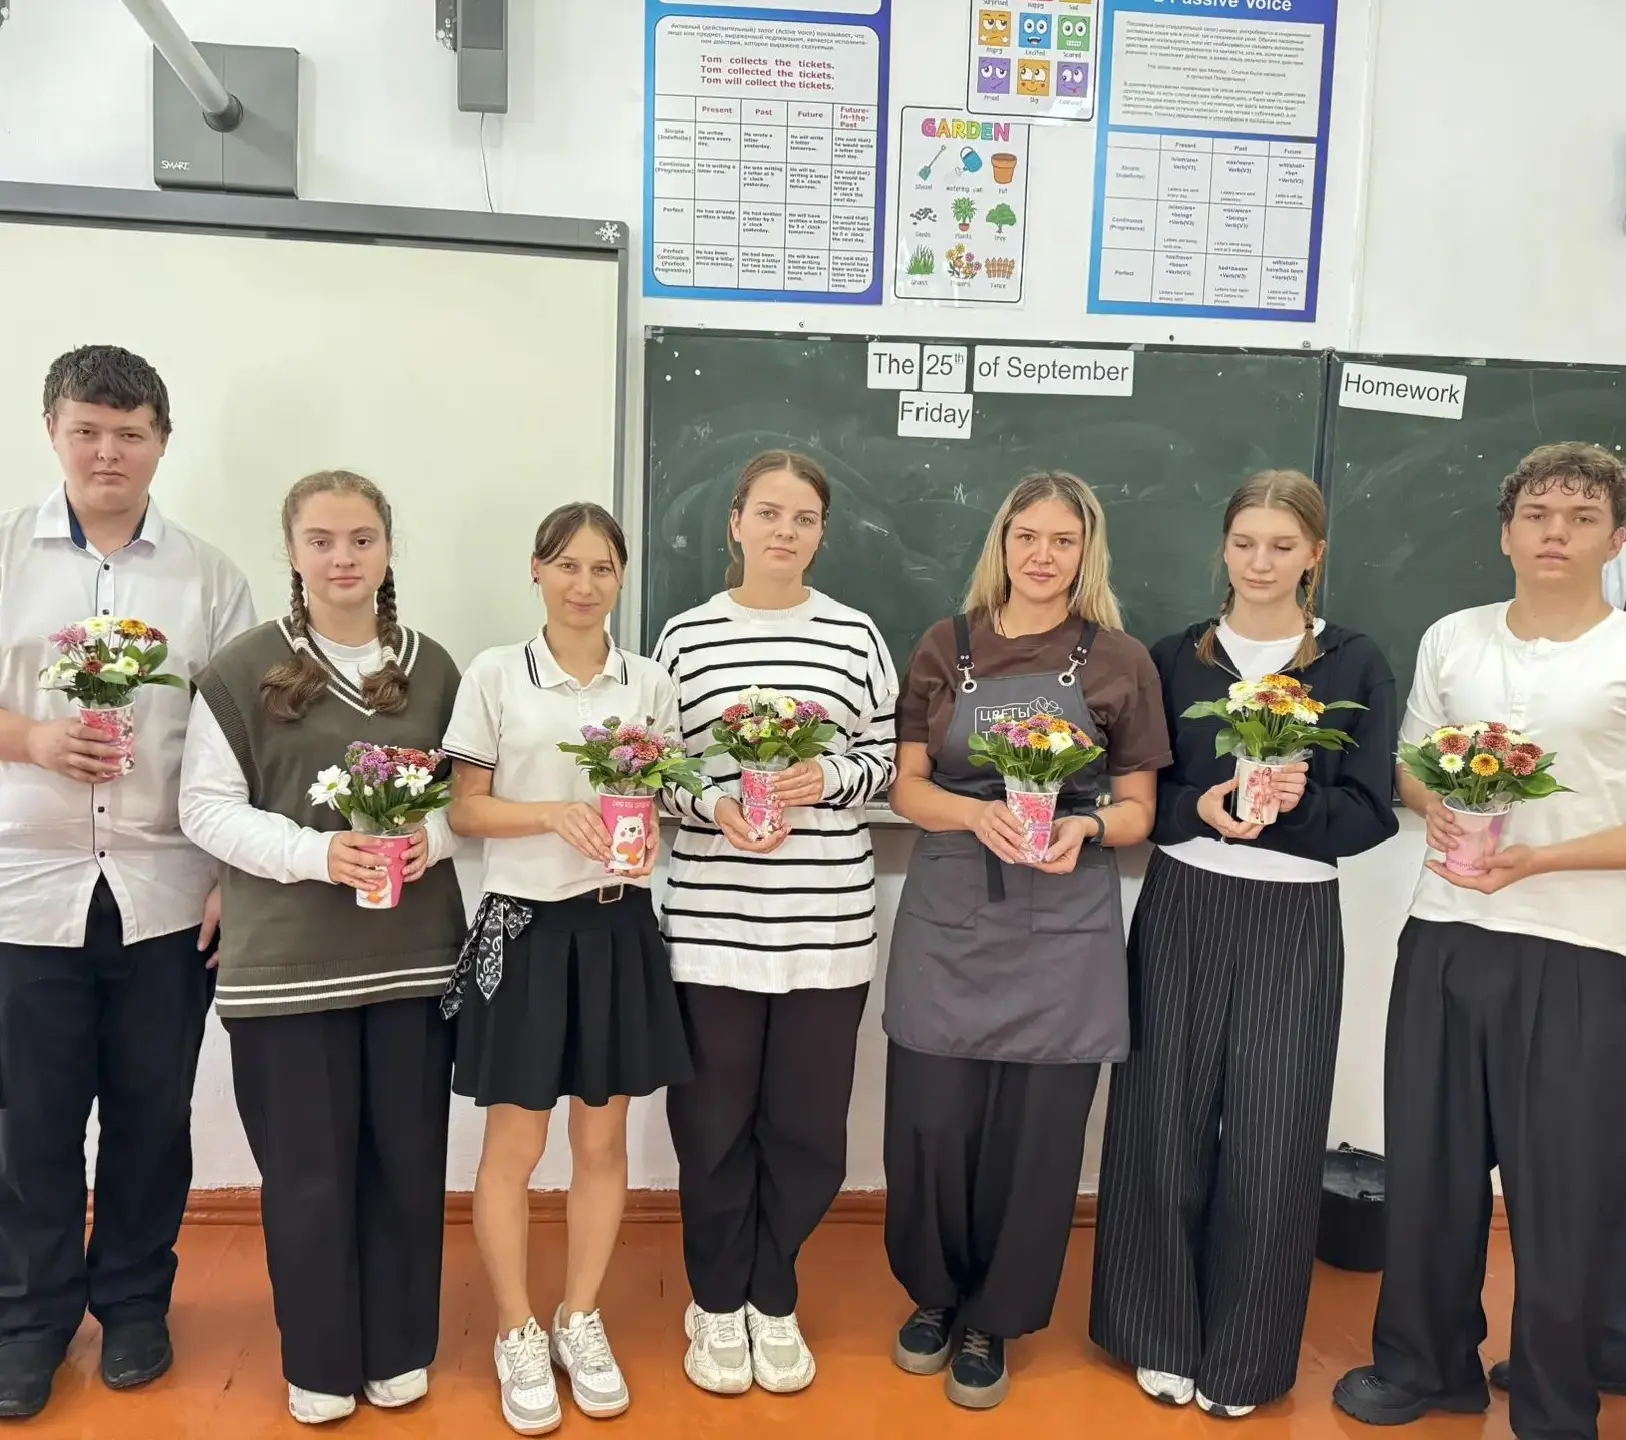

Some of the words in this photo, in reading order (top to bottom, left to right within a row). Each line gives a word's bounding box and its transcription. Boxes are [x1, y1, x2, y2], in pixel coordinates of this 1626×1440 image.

[1246, 0, 1292, 11] Voice
[700, 55, 722, 63] Tom
[730, 57, 768, 66] collects
[775, 59, 792, 67] the
[799, 60, 835, 70] tickets.
[700, 65, 722, 74] Tom
[728, 67, 772, 77] collected
[777, 69, 794, 78] the
[799, 70, 835, 80] tickets.
[700, 76, 722, 85] Tom
[725, 77, 742, 85] will
[745, 78, 778, 87] collect
[780, 80, 797, 88] the
[799, 81, 835, 91] tickets.
[702, 106, 733, 114] Present
[840, 106, 870, 114] Future-
[921, 117, 1011, 142] GARDEN
[160, 160, 188, 171] SMART
[873, 352, 914, 375] The
[925, 352, 965, 376] 25th
[978, 356, 1000, 378] of
[1006, 356, 1129, 384] September
[1345, 372, 1460, 405] Homework
[900, 401, 970, 429] Friday
